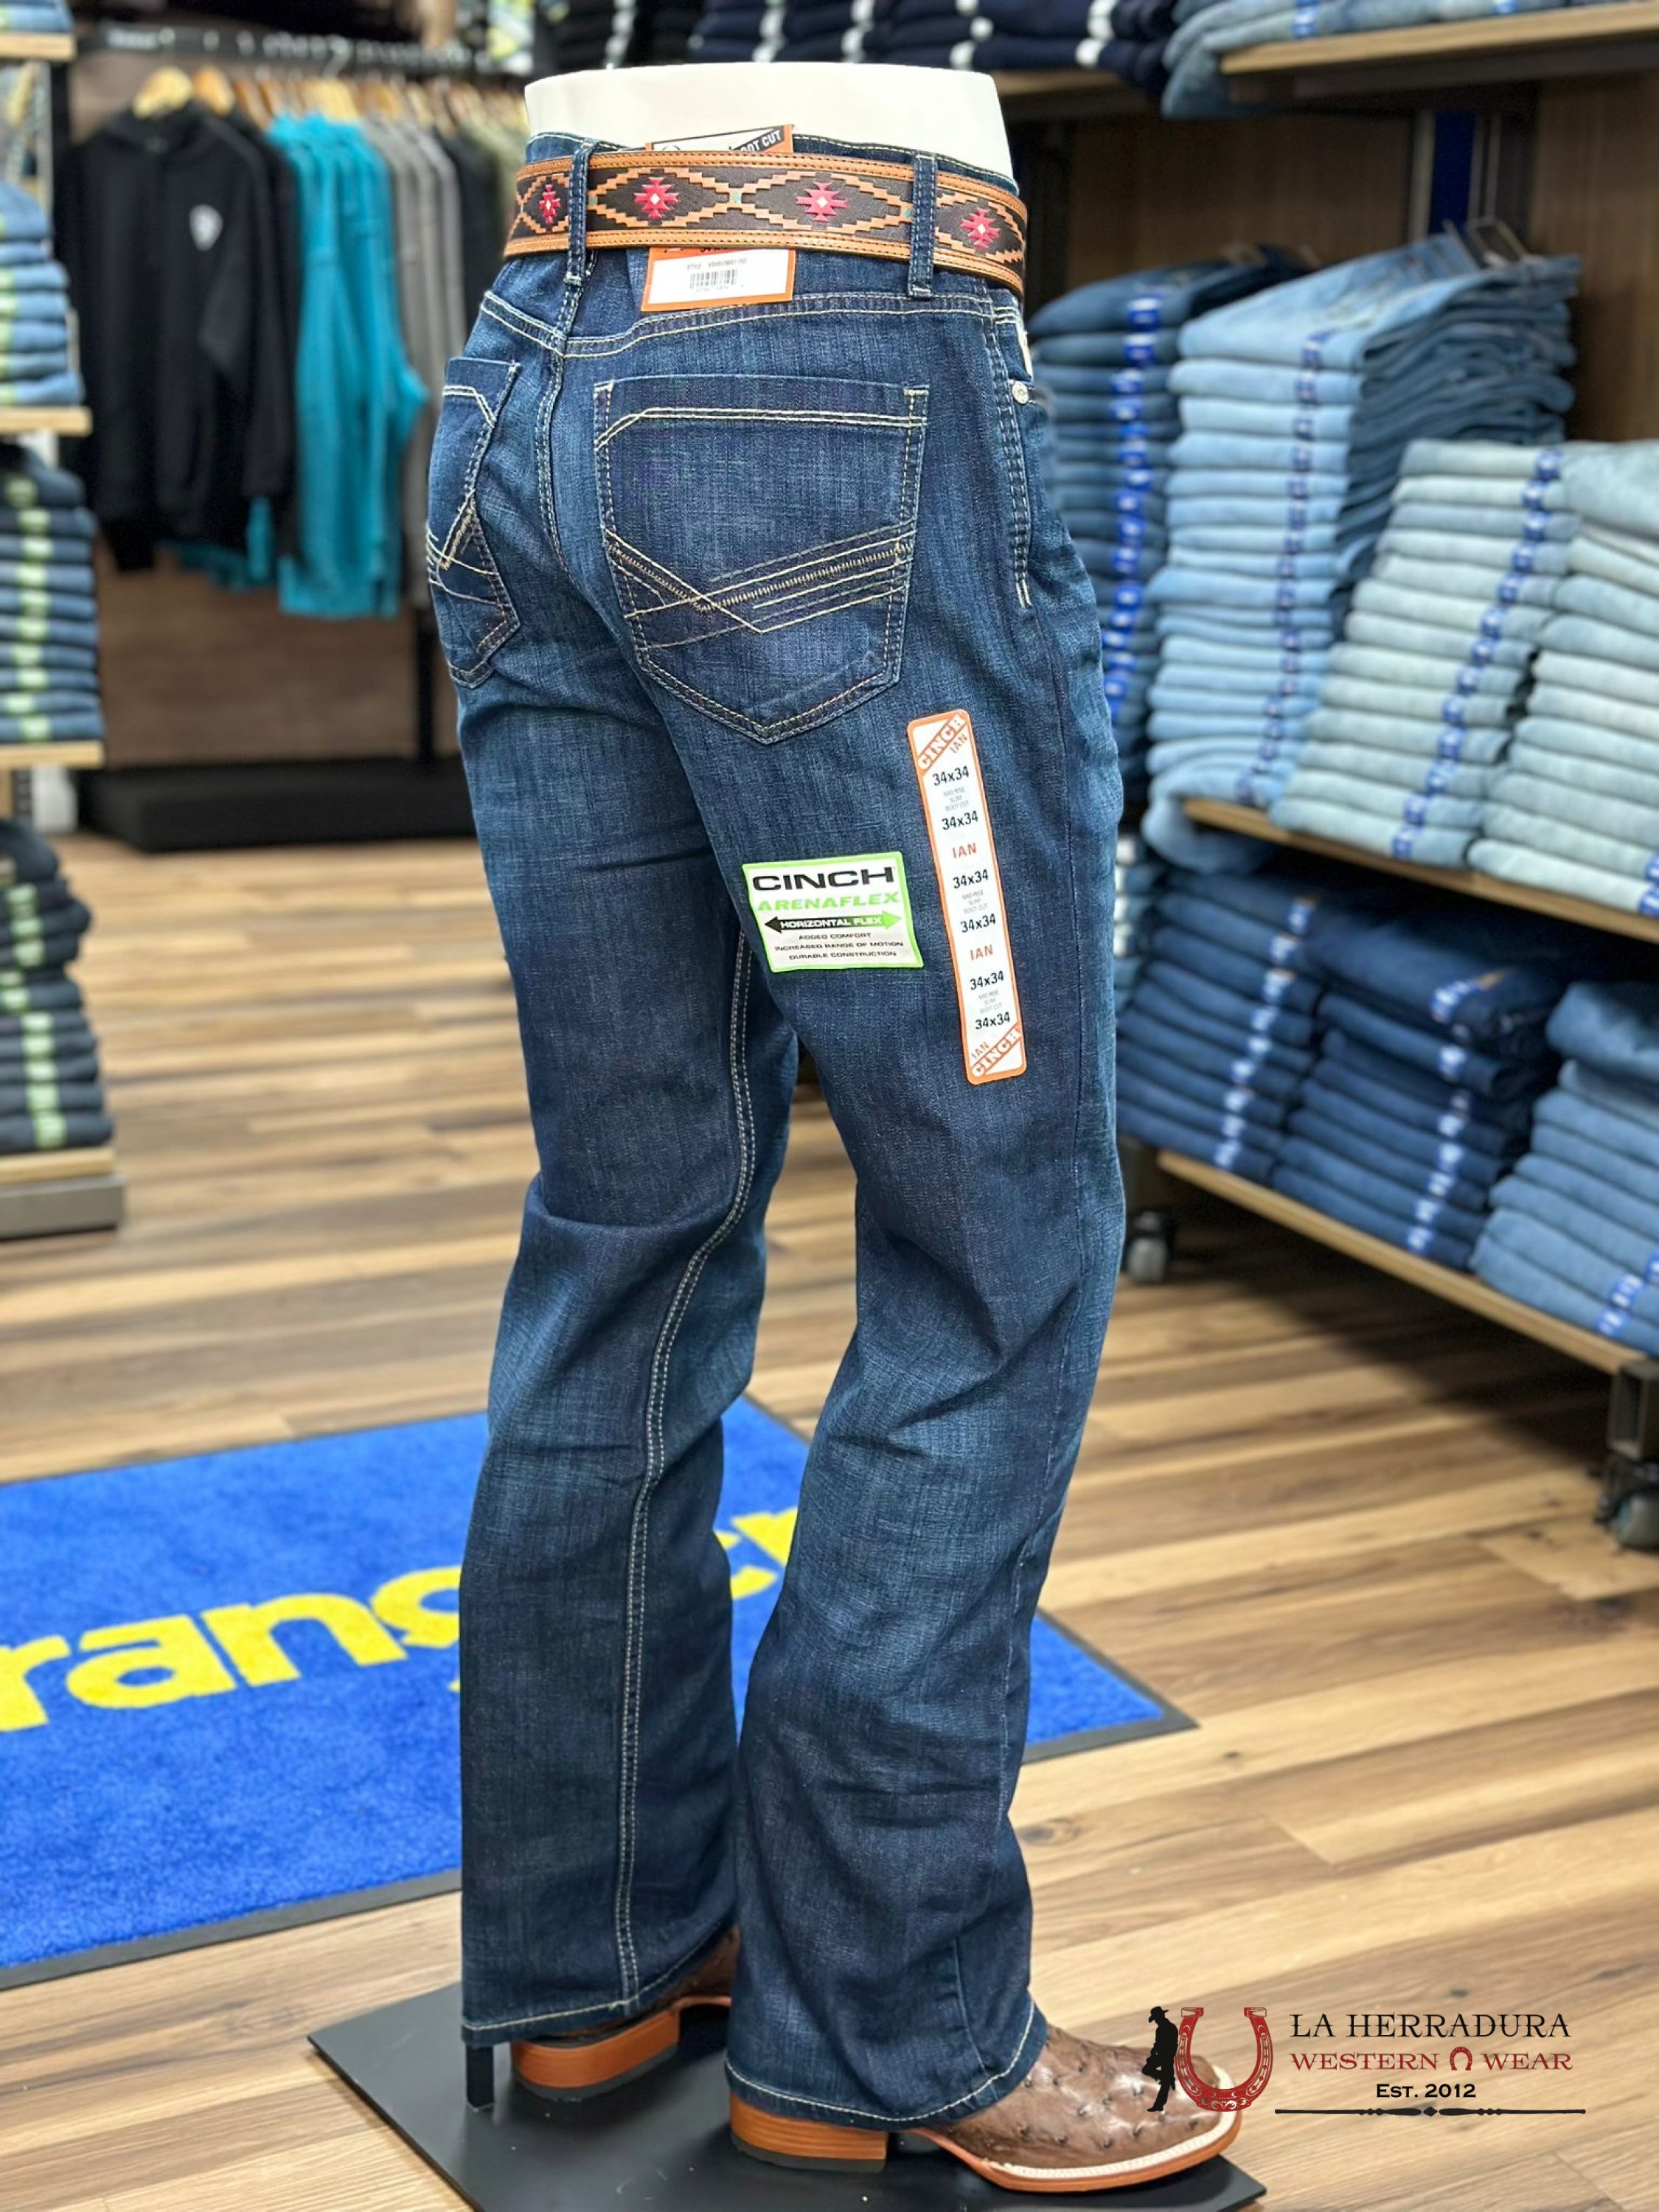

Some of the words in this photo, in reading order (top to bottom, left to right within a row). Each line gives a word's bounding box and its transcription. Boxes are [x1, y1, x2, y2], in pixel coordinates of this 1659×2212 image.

[762, 130, 782, 146] CUT
[917, 714, 966, 770] CINCH
[950, 734, 967, 754] IAN
[933, 765, 970, 786] 34x34
[942, 810, 978, 830] 34x34
[953, 843, 977, 858] IAN
[752, 867, 894, 891] CINCH
[953, 869, 989, 888] 34x34
[758, 892, 900, 911] ARENAFLEX
[780, 918, 851, 929] HORIZONTAL
[852, 917, 882, 925] FLEX
[960, 914, 996, 933] 34x34
[970, 945, 993, 960] IAN
[970, 970, 1004, 990] 34x34
[975, 1012, 1010, 1030] 34x34
[971, 1042, 990, 1059] IAN
[971, 1029, 1021, 1077] CINCH
